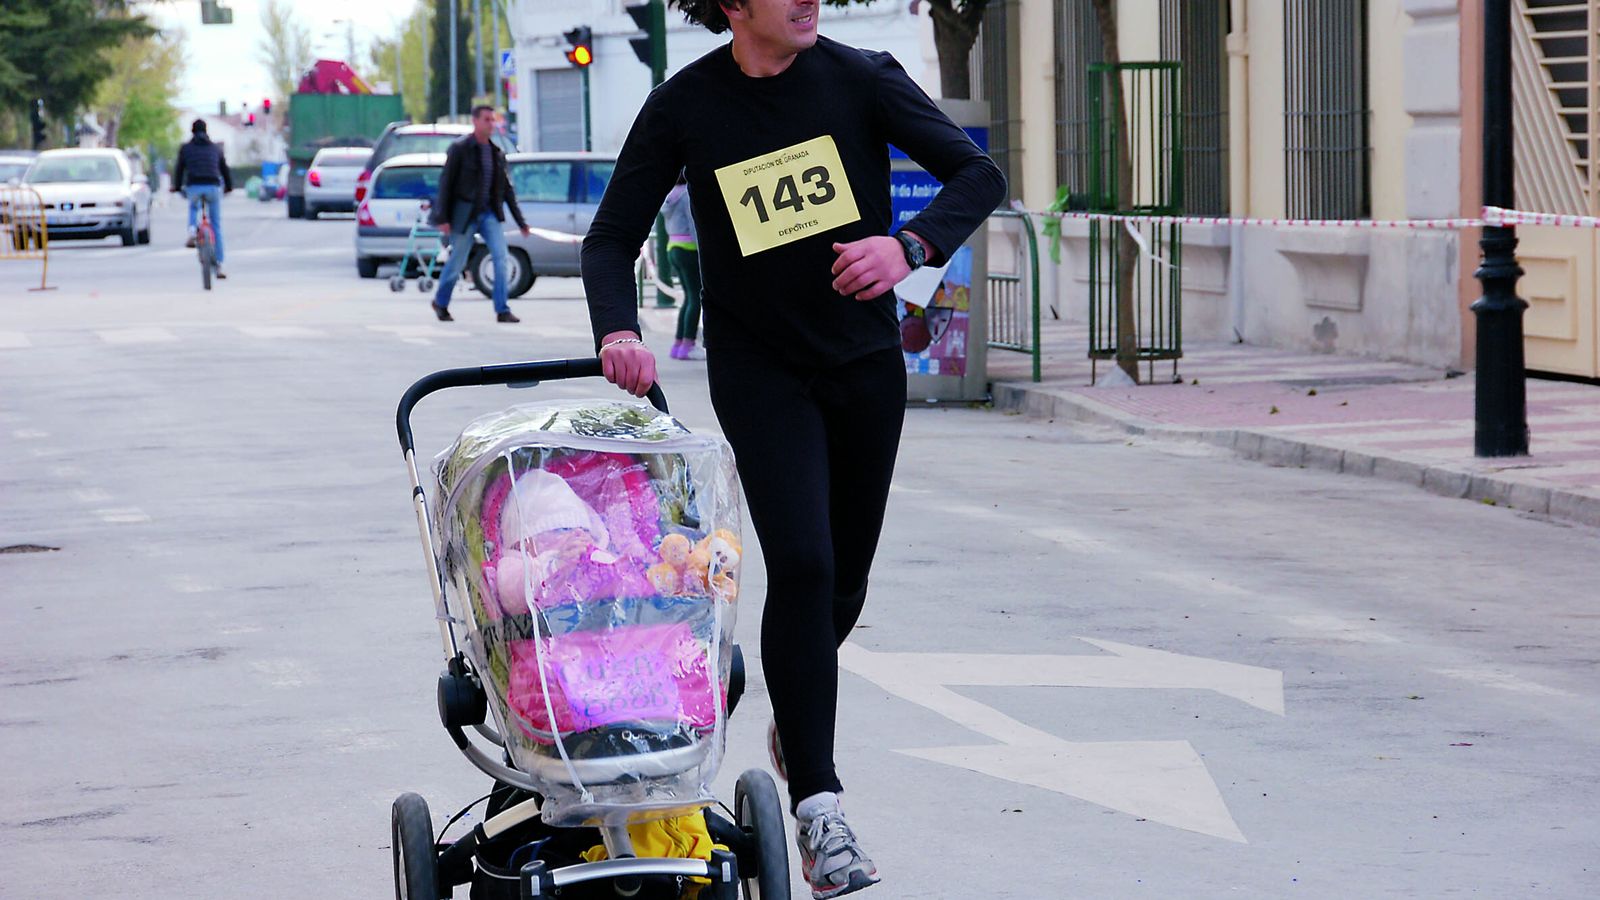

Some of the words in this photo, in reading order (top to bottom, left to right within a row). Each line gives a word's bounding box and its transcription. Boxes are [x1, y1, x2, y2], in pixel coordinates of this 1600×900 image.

[775, 158, 784, 166] DE
[783, 150, 810, 163] GRANADA
[739, 165, 836, 224] 143
[778, 219, 819, 237] DEPORTES
[621, 729, 668, 742] Quinny
